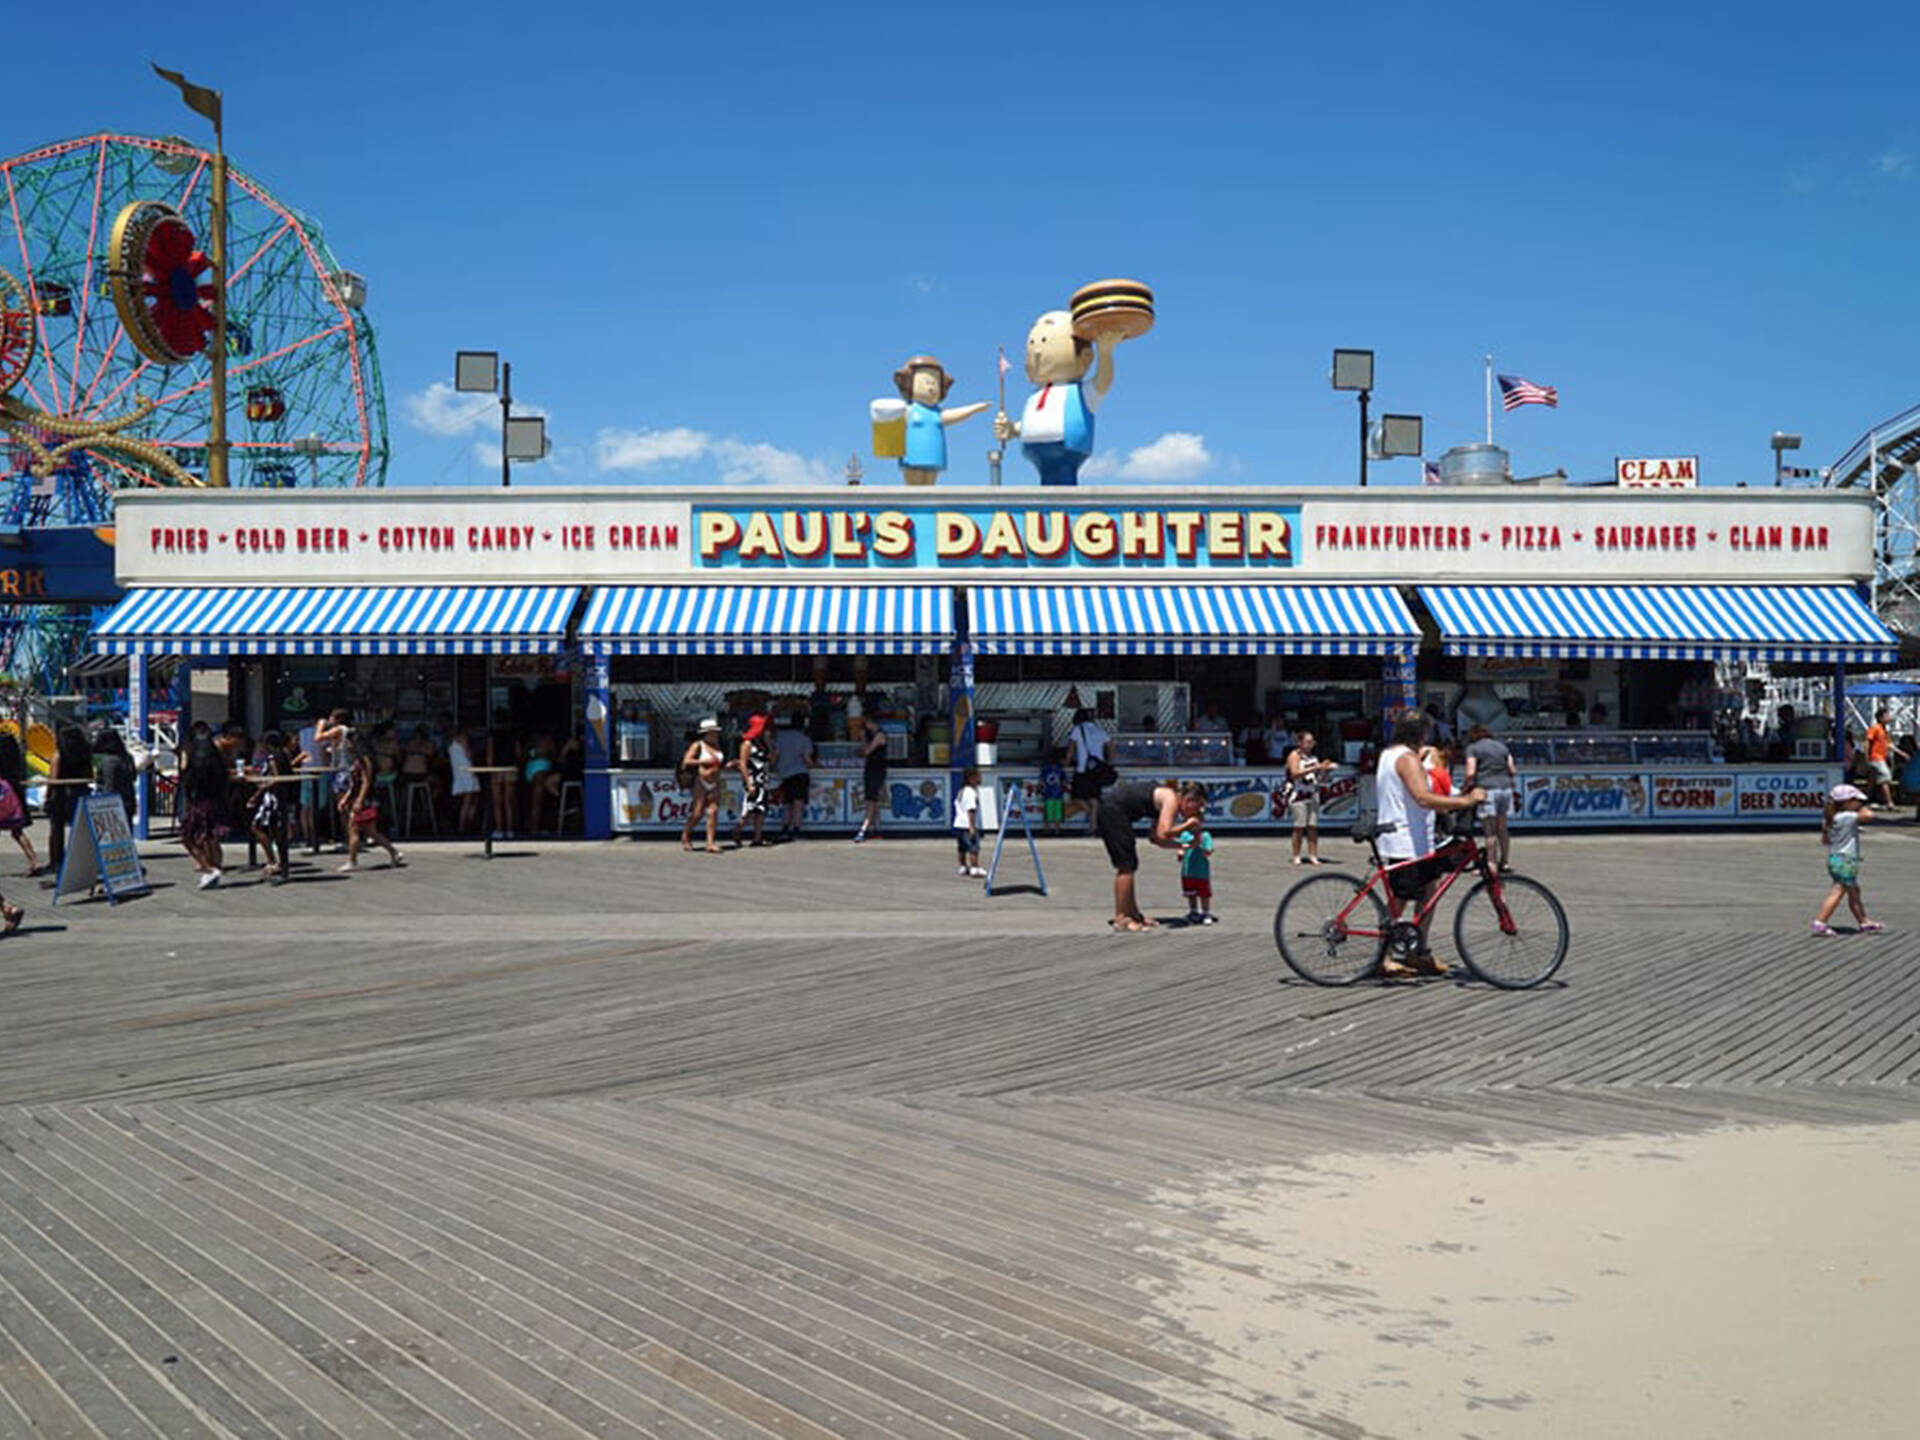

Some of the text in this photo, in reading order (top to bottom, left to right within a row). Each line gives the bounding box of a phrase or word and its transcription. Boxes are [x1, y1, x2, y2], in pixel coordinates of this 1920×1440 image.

[1621, 460, 1694, 481] CLAM
[151, 524, 678, 552] FRIES COLD BEER COTTON CANDY ICE CREAM
[700, 511, 1292, 560] PAUL'S DAUGHTER
[1315, 524, 1829, 550] FRANKFURTERS PIZZA SAUSAGES CLAM BAR
[1755, 777, 1809, 790] COLD
[1529, 788, 1625, 818] CHICKEN
[1657, 789, 1716, 809] CORN
[1740, 792, 1776, 809] BEER
